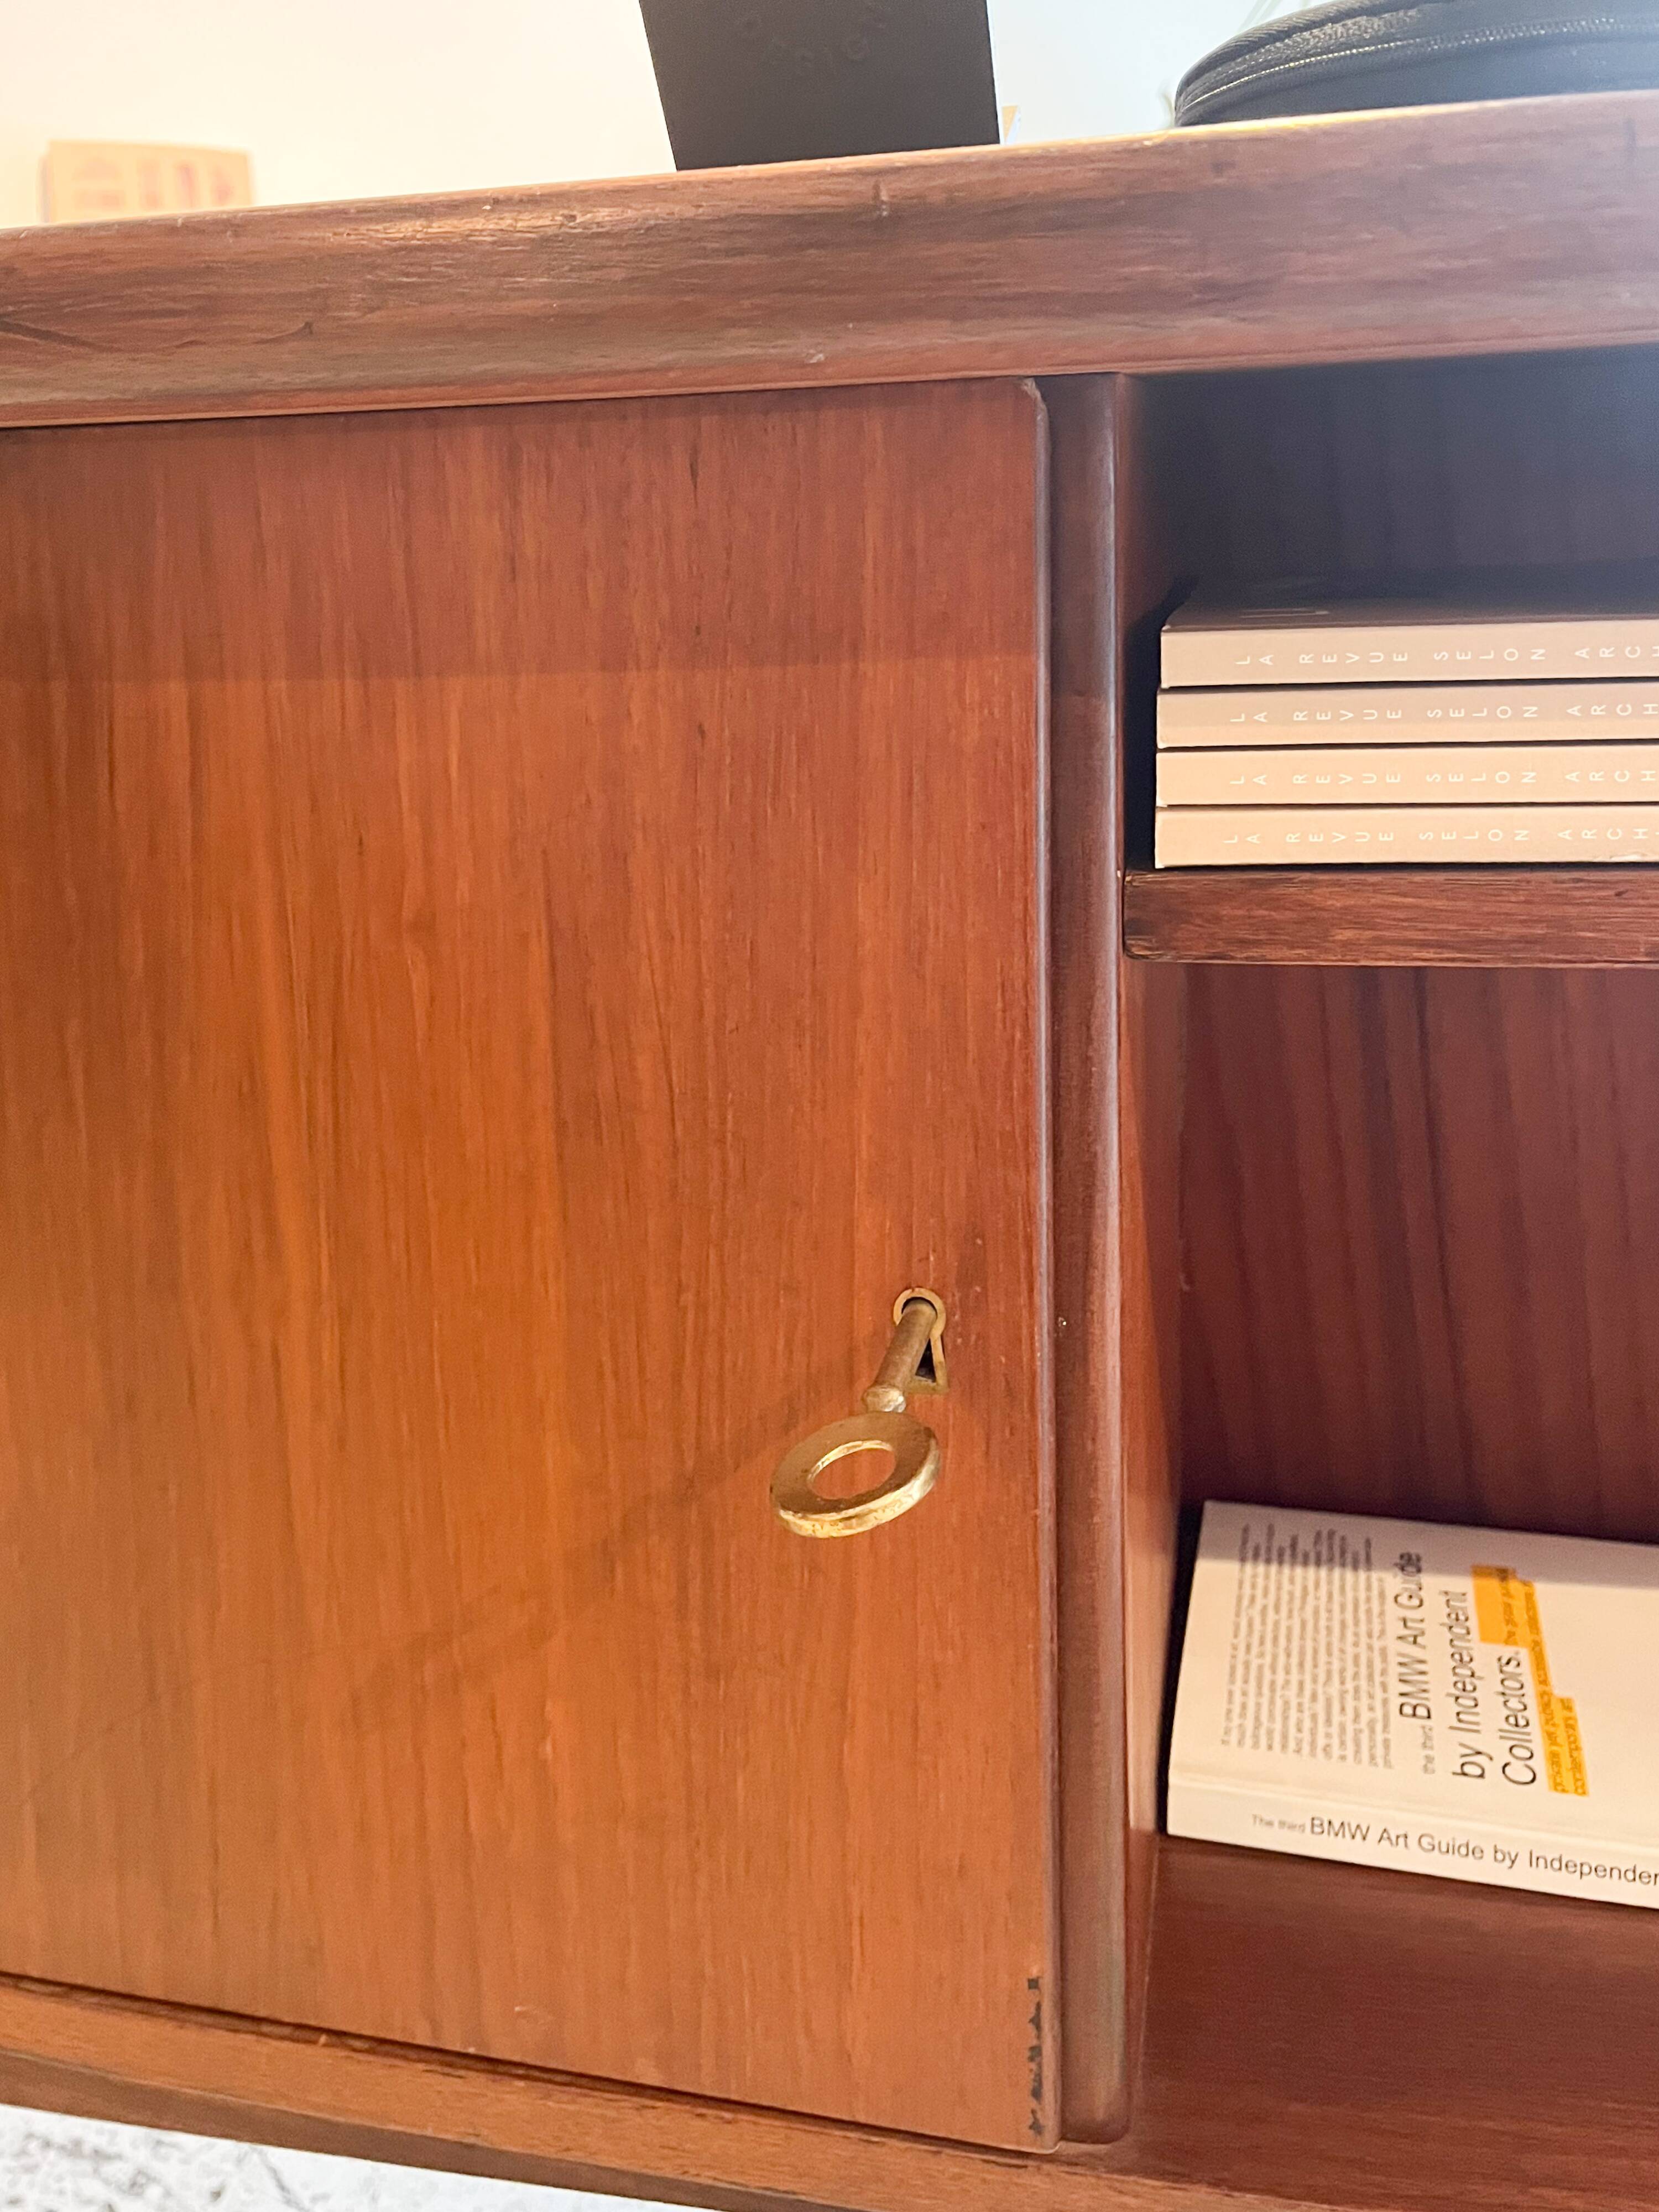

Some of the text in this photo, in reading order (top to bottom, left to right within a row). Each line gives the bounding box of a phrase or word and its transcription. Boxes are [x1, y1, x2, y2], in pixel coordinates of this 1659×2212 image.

[1235, 654, 1274, 665] LA
[1299, 653, 1408, 664] REVUE
[1433, 648, 1546, 661] SELON
[1229, 703, 1658, 723] LA REVUE SELON ARCH
[1229, 770, 1656, 786] LA REVUE SELON ARCH
[1223, 834, 1260, 844] LA
[1285, 832, 1394, 843] REVUE
[1418, 829, 1530, 842] SELON
[1394, 1551, 1424, 1610] Guide
[1396, 1616, 1426, 1649] Art
[1397, 1652, 1431, 1720] BMW
[1439, 1589, 1494, 1780] by Independent
[1494, 1650, 1537, 1786] Collectors.
[1310, 1816, 1371, 1841] BMW
[1378, 1827, 1409, 1849] Art
[1417, 1833, 1485, 1861] Guide
[1493, 1844, 1520, 1870] by
